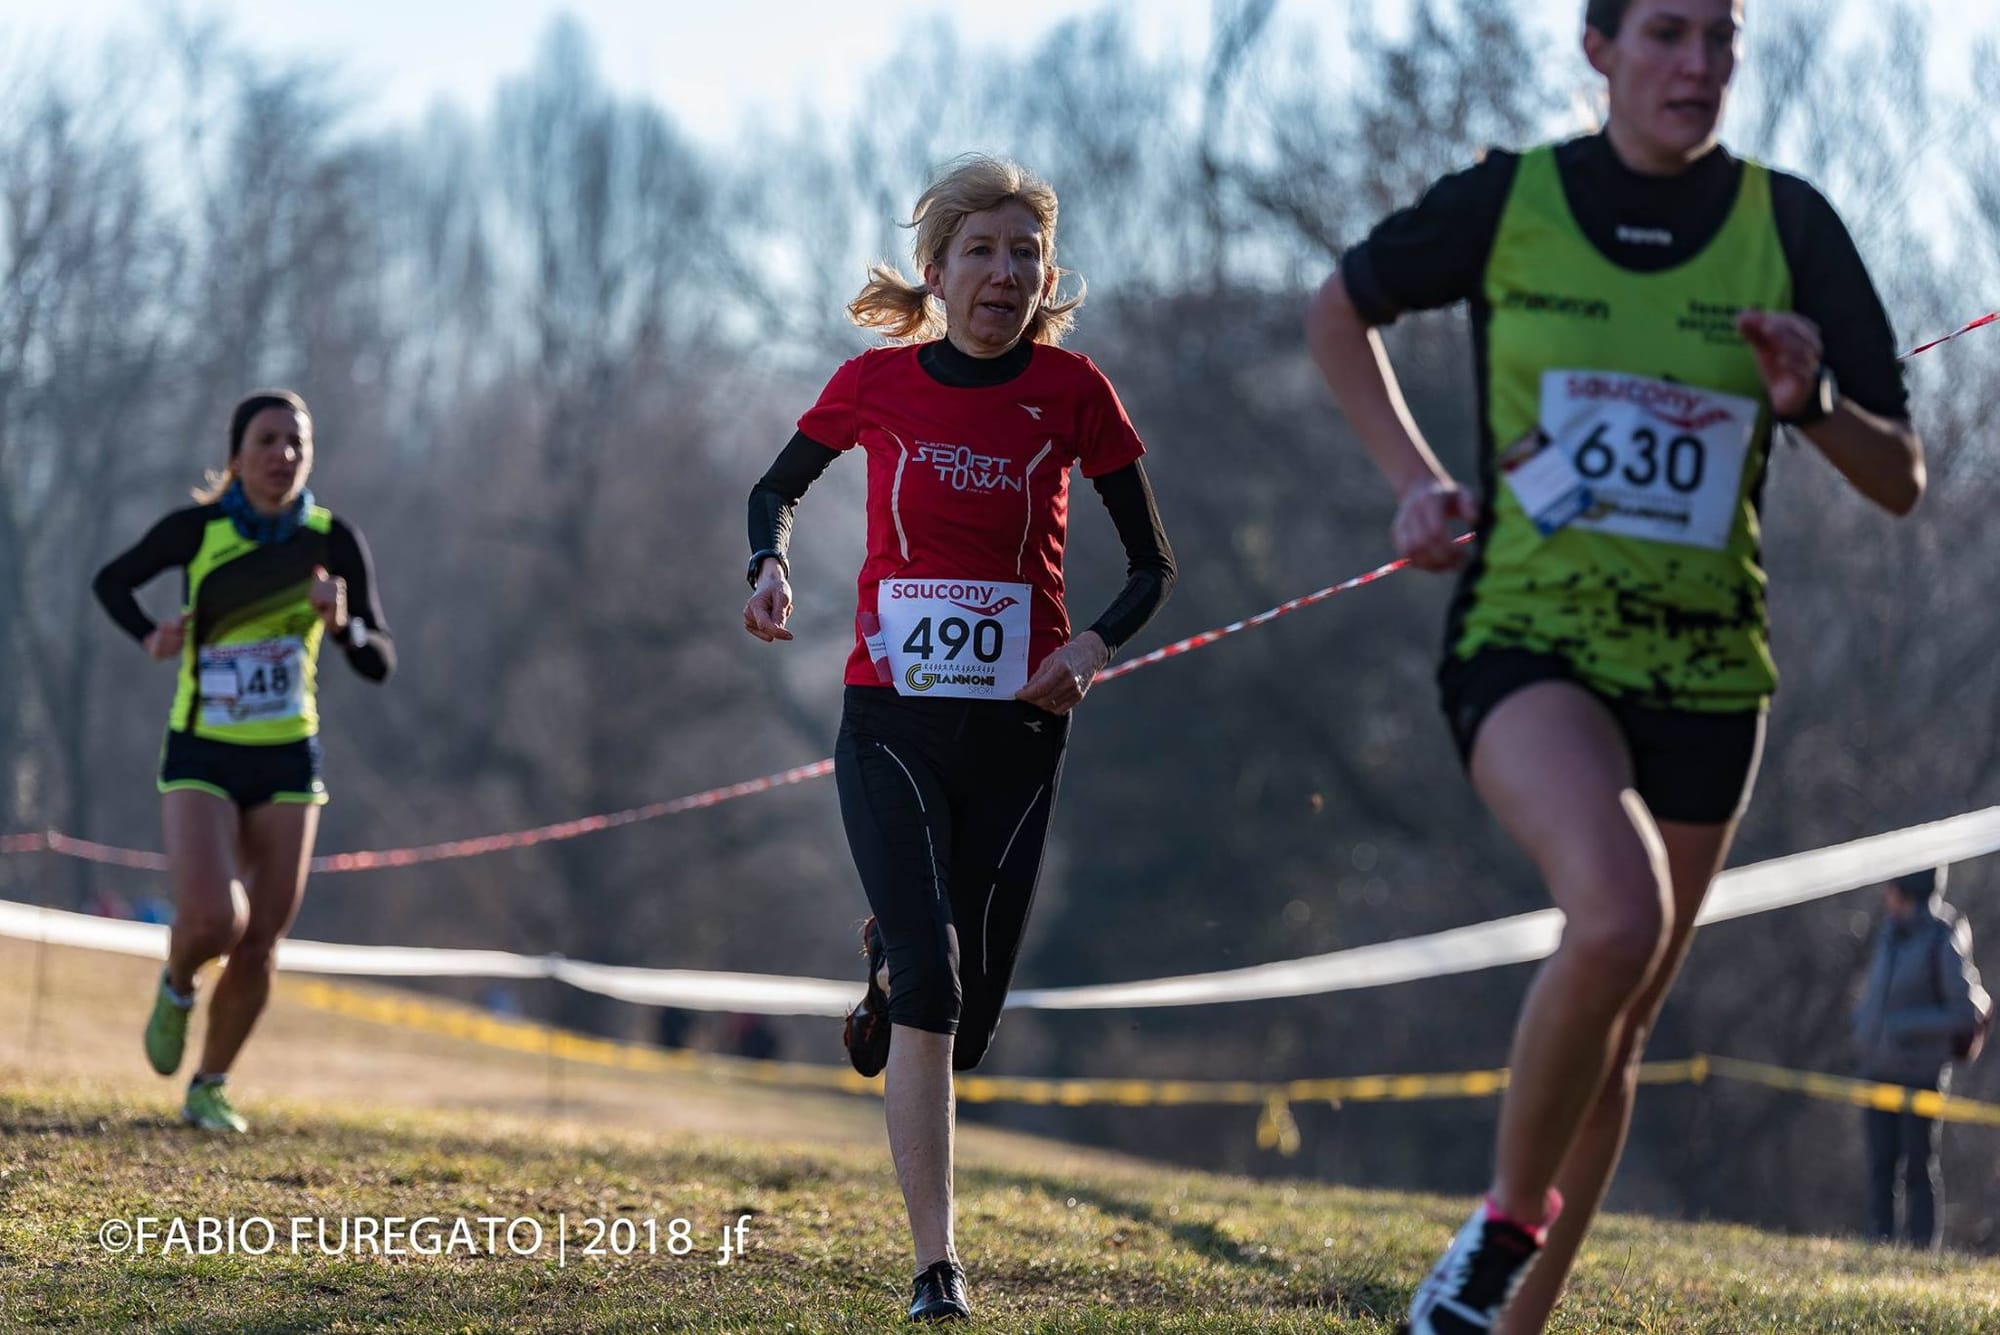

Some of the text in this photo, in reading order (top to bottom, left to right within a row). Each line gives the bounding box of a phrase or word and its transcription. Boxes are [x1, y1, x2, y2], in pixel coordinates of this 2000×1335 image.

[1566, 376, 1702, 412] saucony
[912, 446, 1012, 473] SPORT
[1573, 422, 1707, 493] 630
[934, 465, 1022, 492] TOWN
[891, 583, 994, 605] saucony
[902, 617, 1004, 663] 490
[905, 663, 995, 692] GIANNONE
